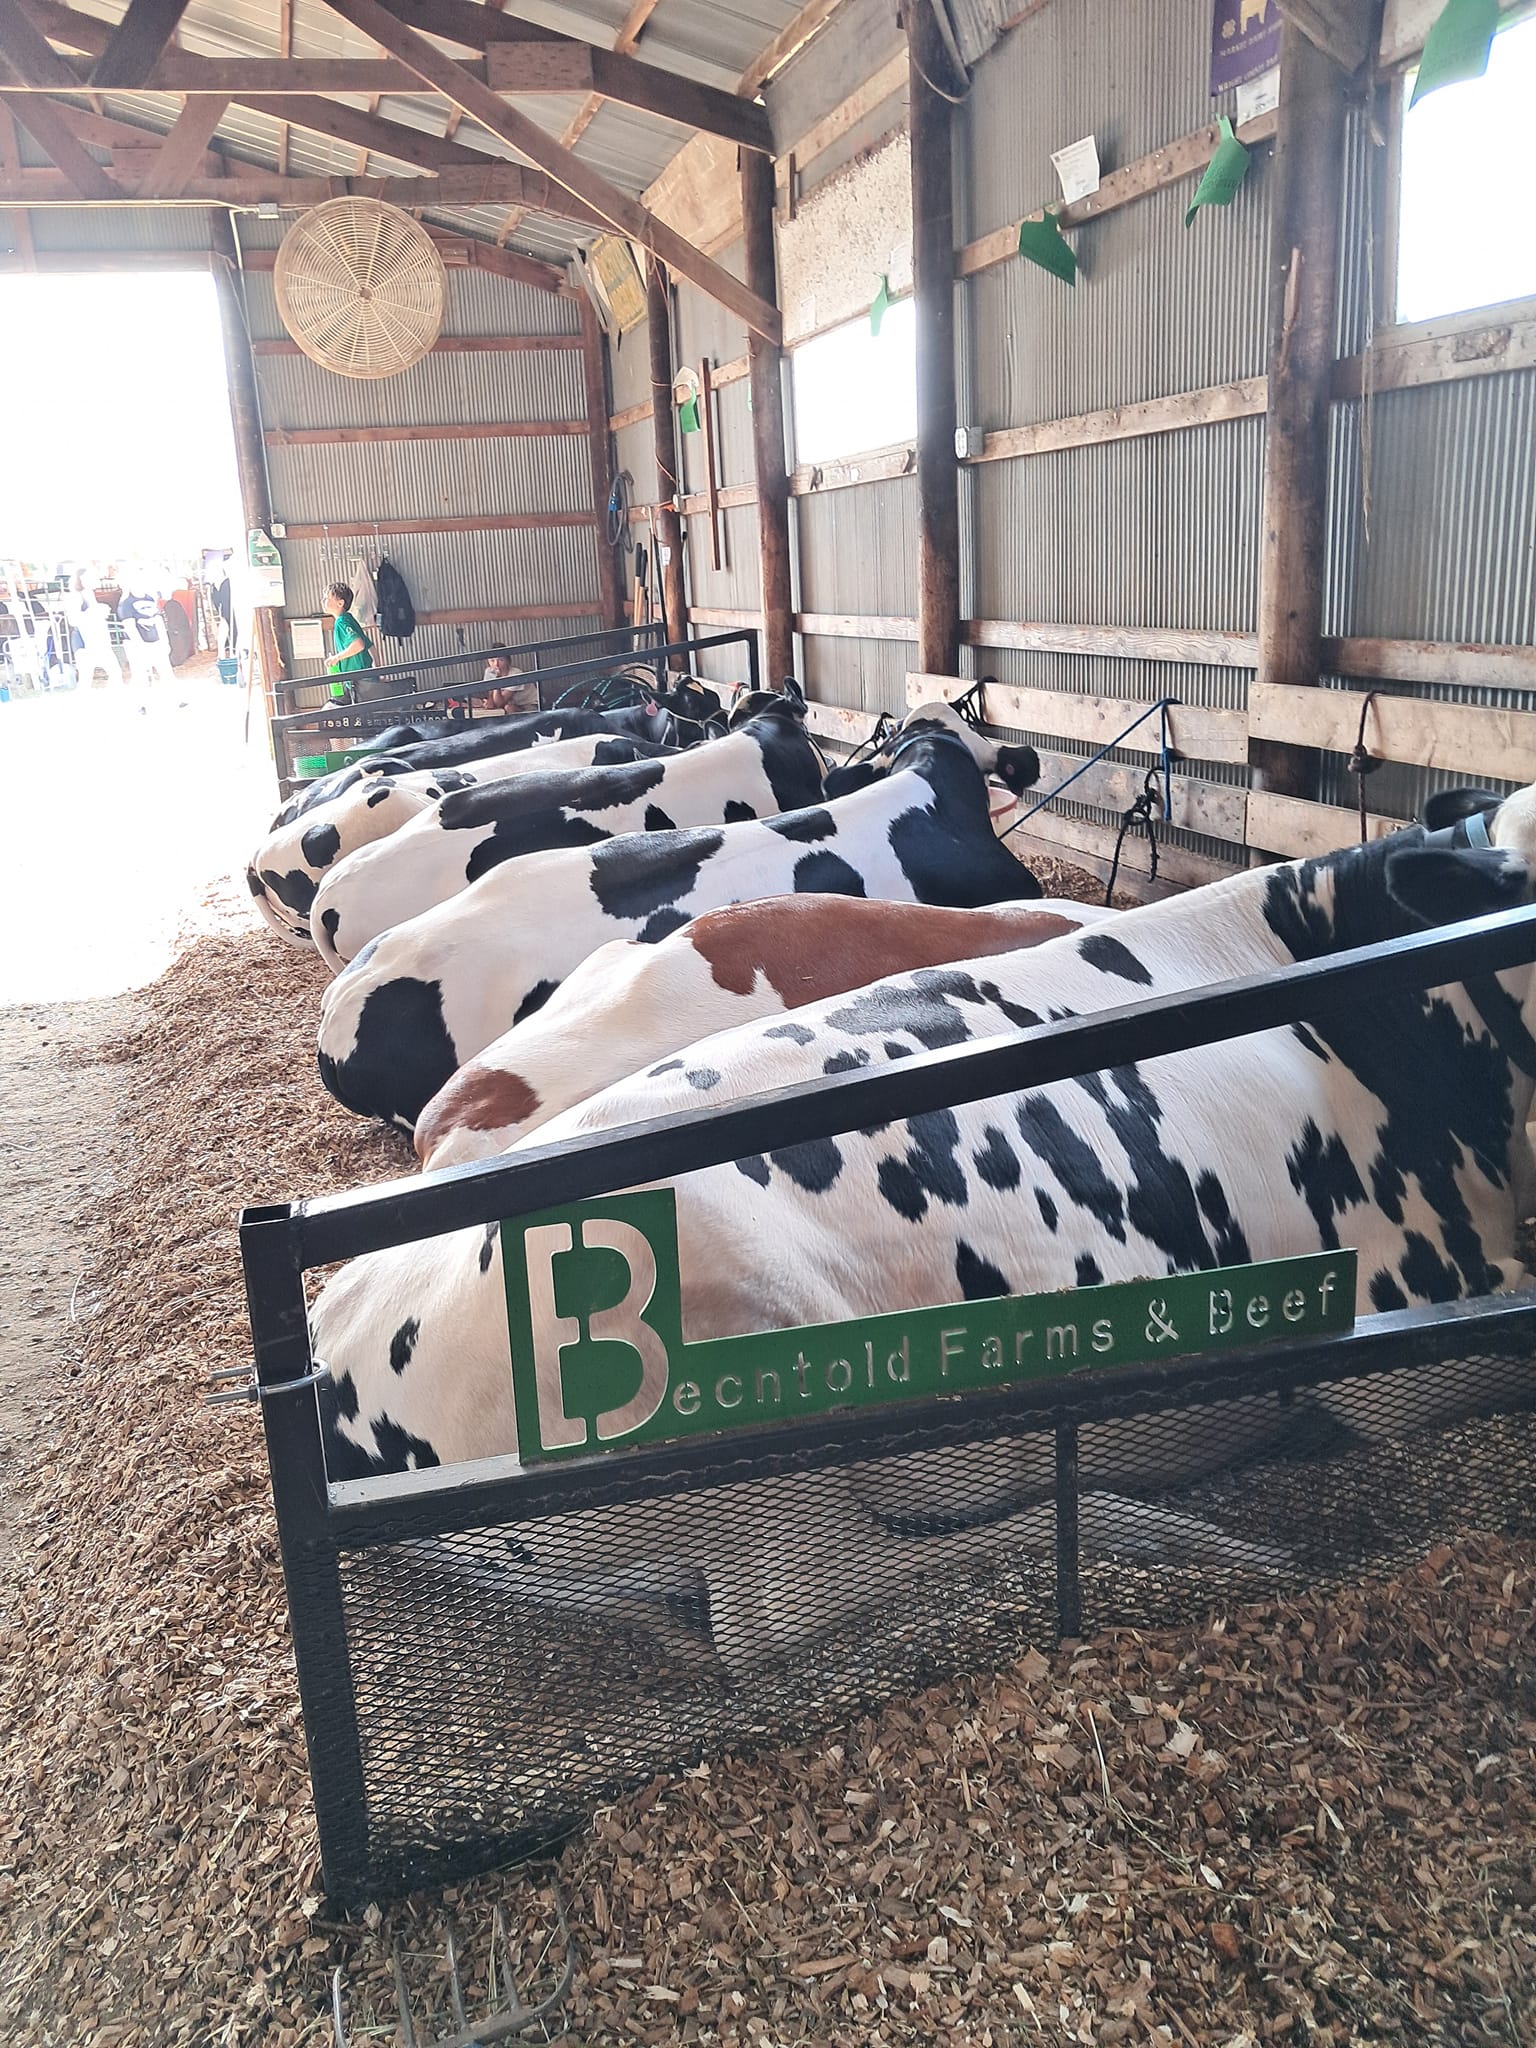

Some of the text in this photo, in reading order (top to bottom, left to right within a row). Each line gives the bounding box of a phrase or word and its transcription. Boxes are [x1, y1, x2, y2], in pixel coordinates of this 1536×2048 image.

[940, 1317, 1115, 1376] Farms
[1145, 1297, 1180, 1344] &
[1208, 1270, 1338, 1336] Beef
